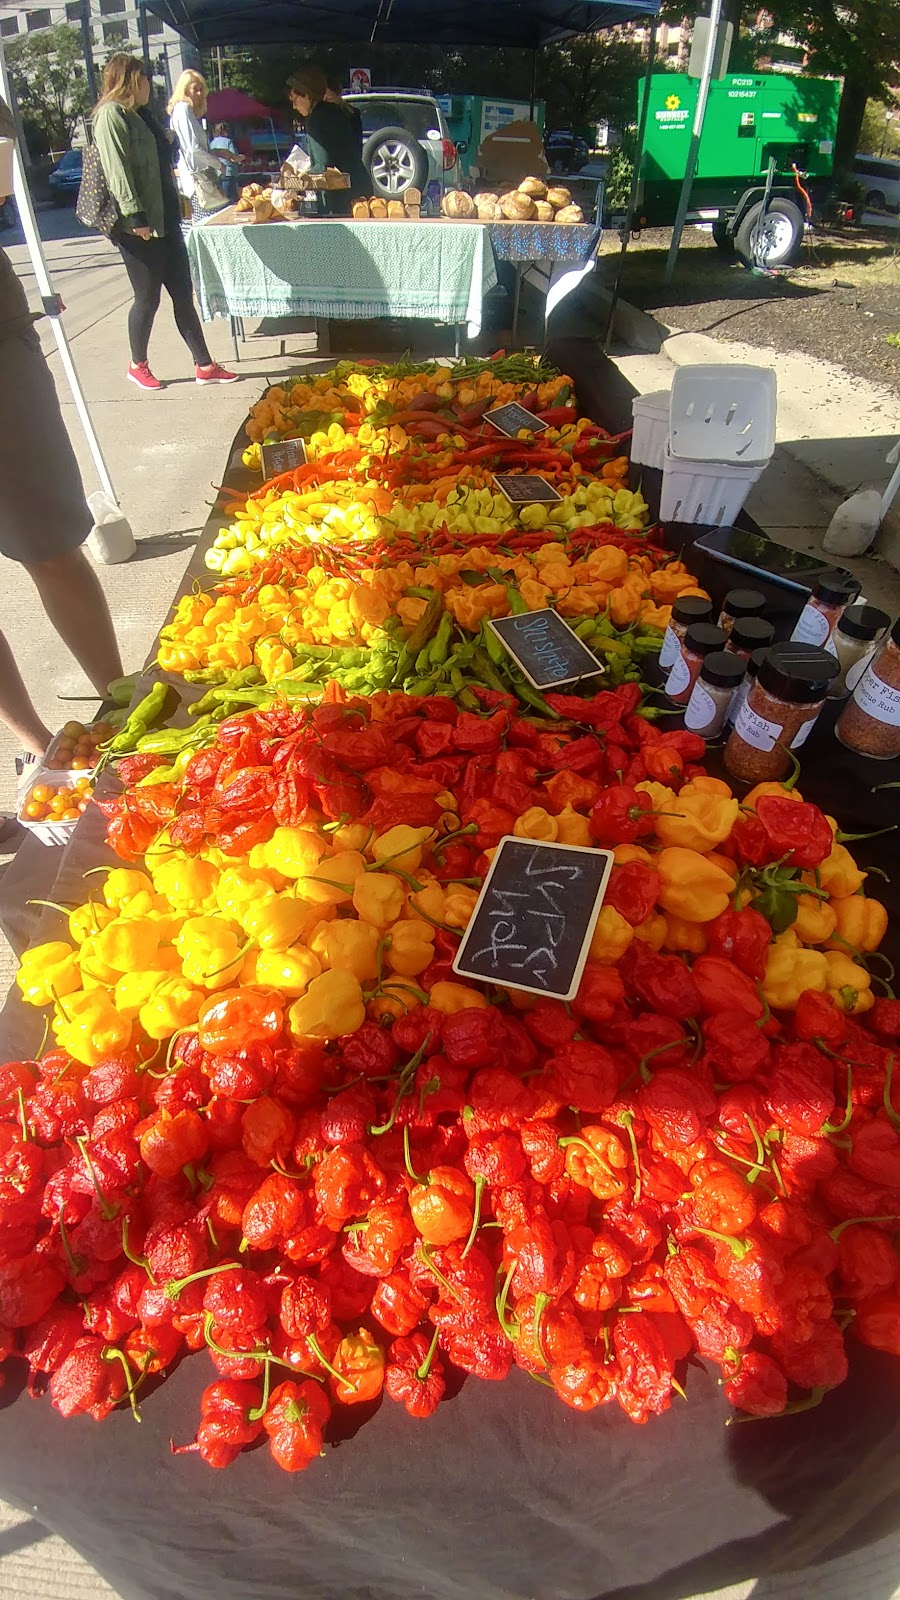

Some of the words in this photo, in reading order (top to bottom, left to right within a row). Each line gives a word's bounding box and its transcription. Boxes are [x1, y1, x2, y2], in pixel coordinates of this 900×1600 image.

[728, 90, 757, 98] 10215437
[877, 700, 896, 714] Rub
[747, 711, 770, 731] Fish
[746, 725, 760, 738] Rub
